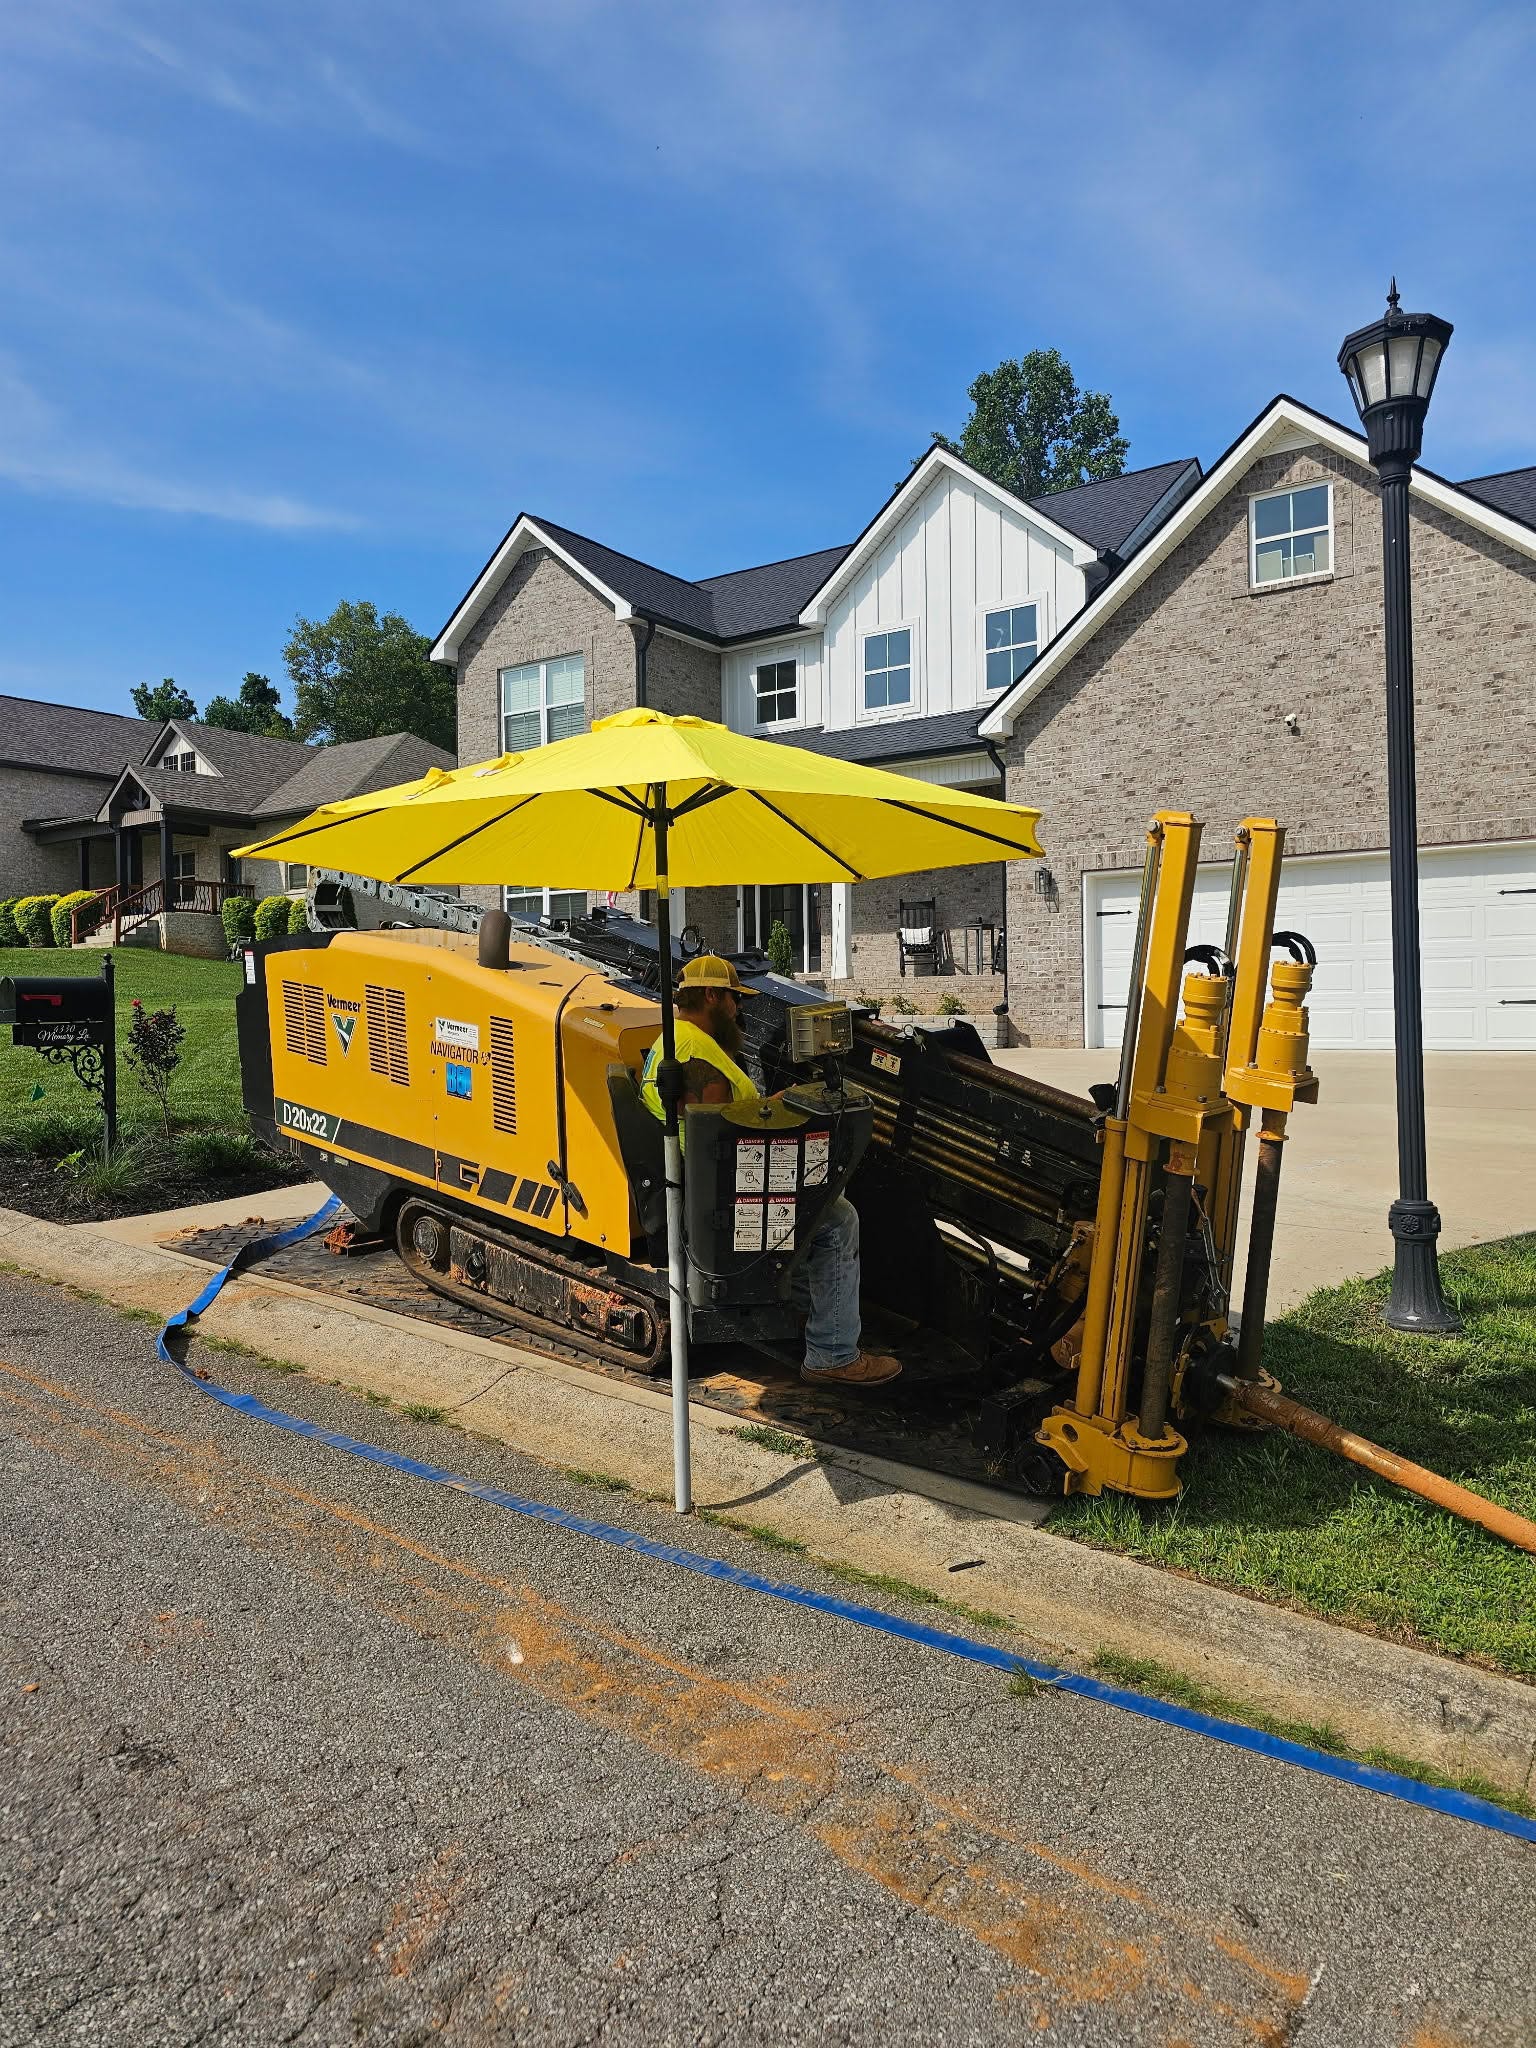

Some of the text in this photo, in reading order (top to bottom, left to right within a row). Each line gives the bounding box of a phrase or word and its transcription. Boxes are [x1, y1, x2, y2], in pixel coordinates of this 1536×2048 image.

[326, 993, 362, 1013] Vermeer
[37, 1030, 75, 1043] Memory
[430, 1040, 479, 1064] NAVIGATOR
[283, 1102, 328, 1138] D20x22
